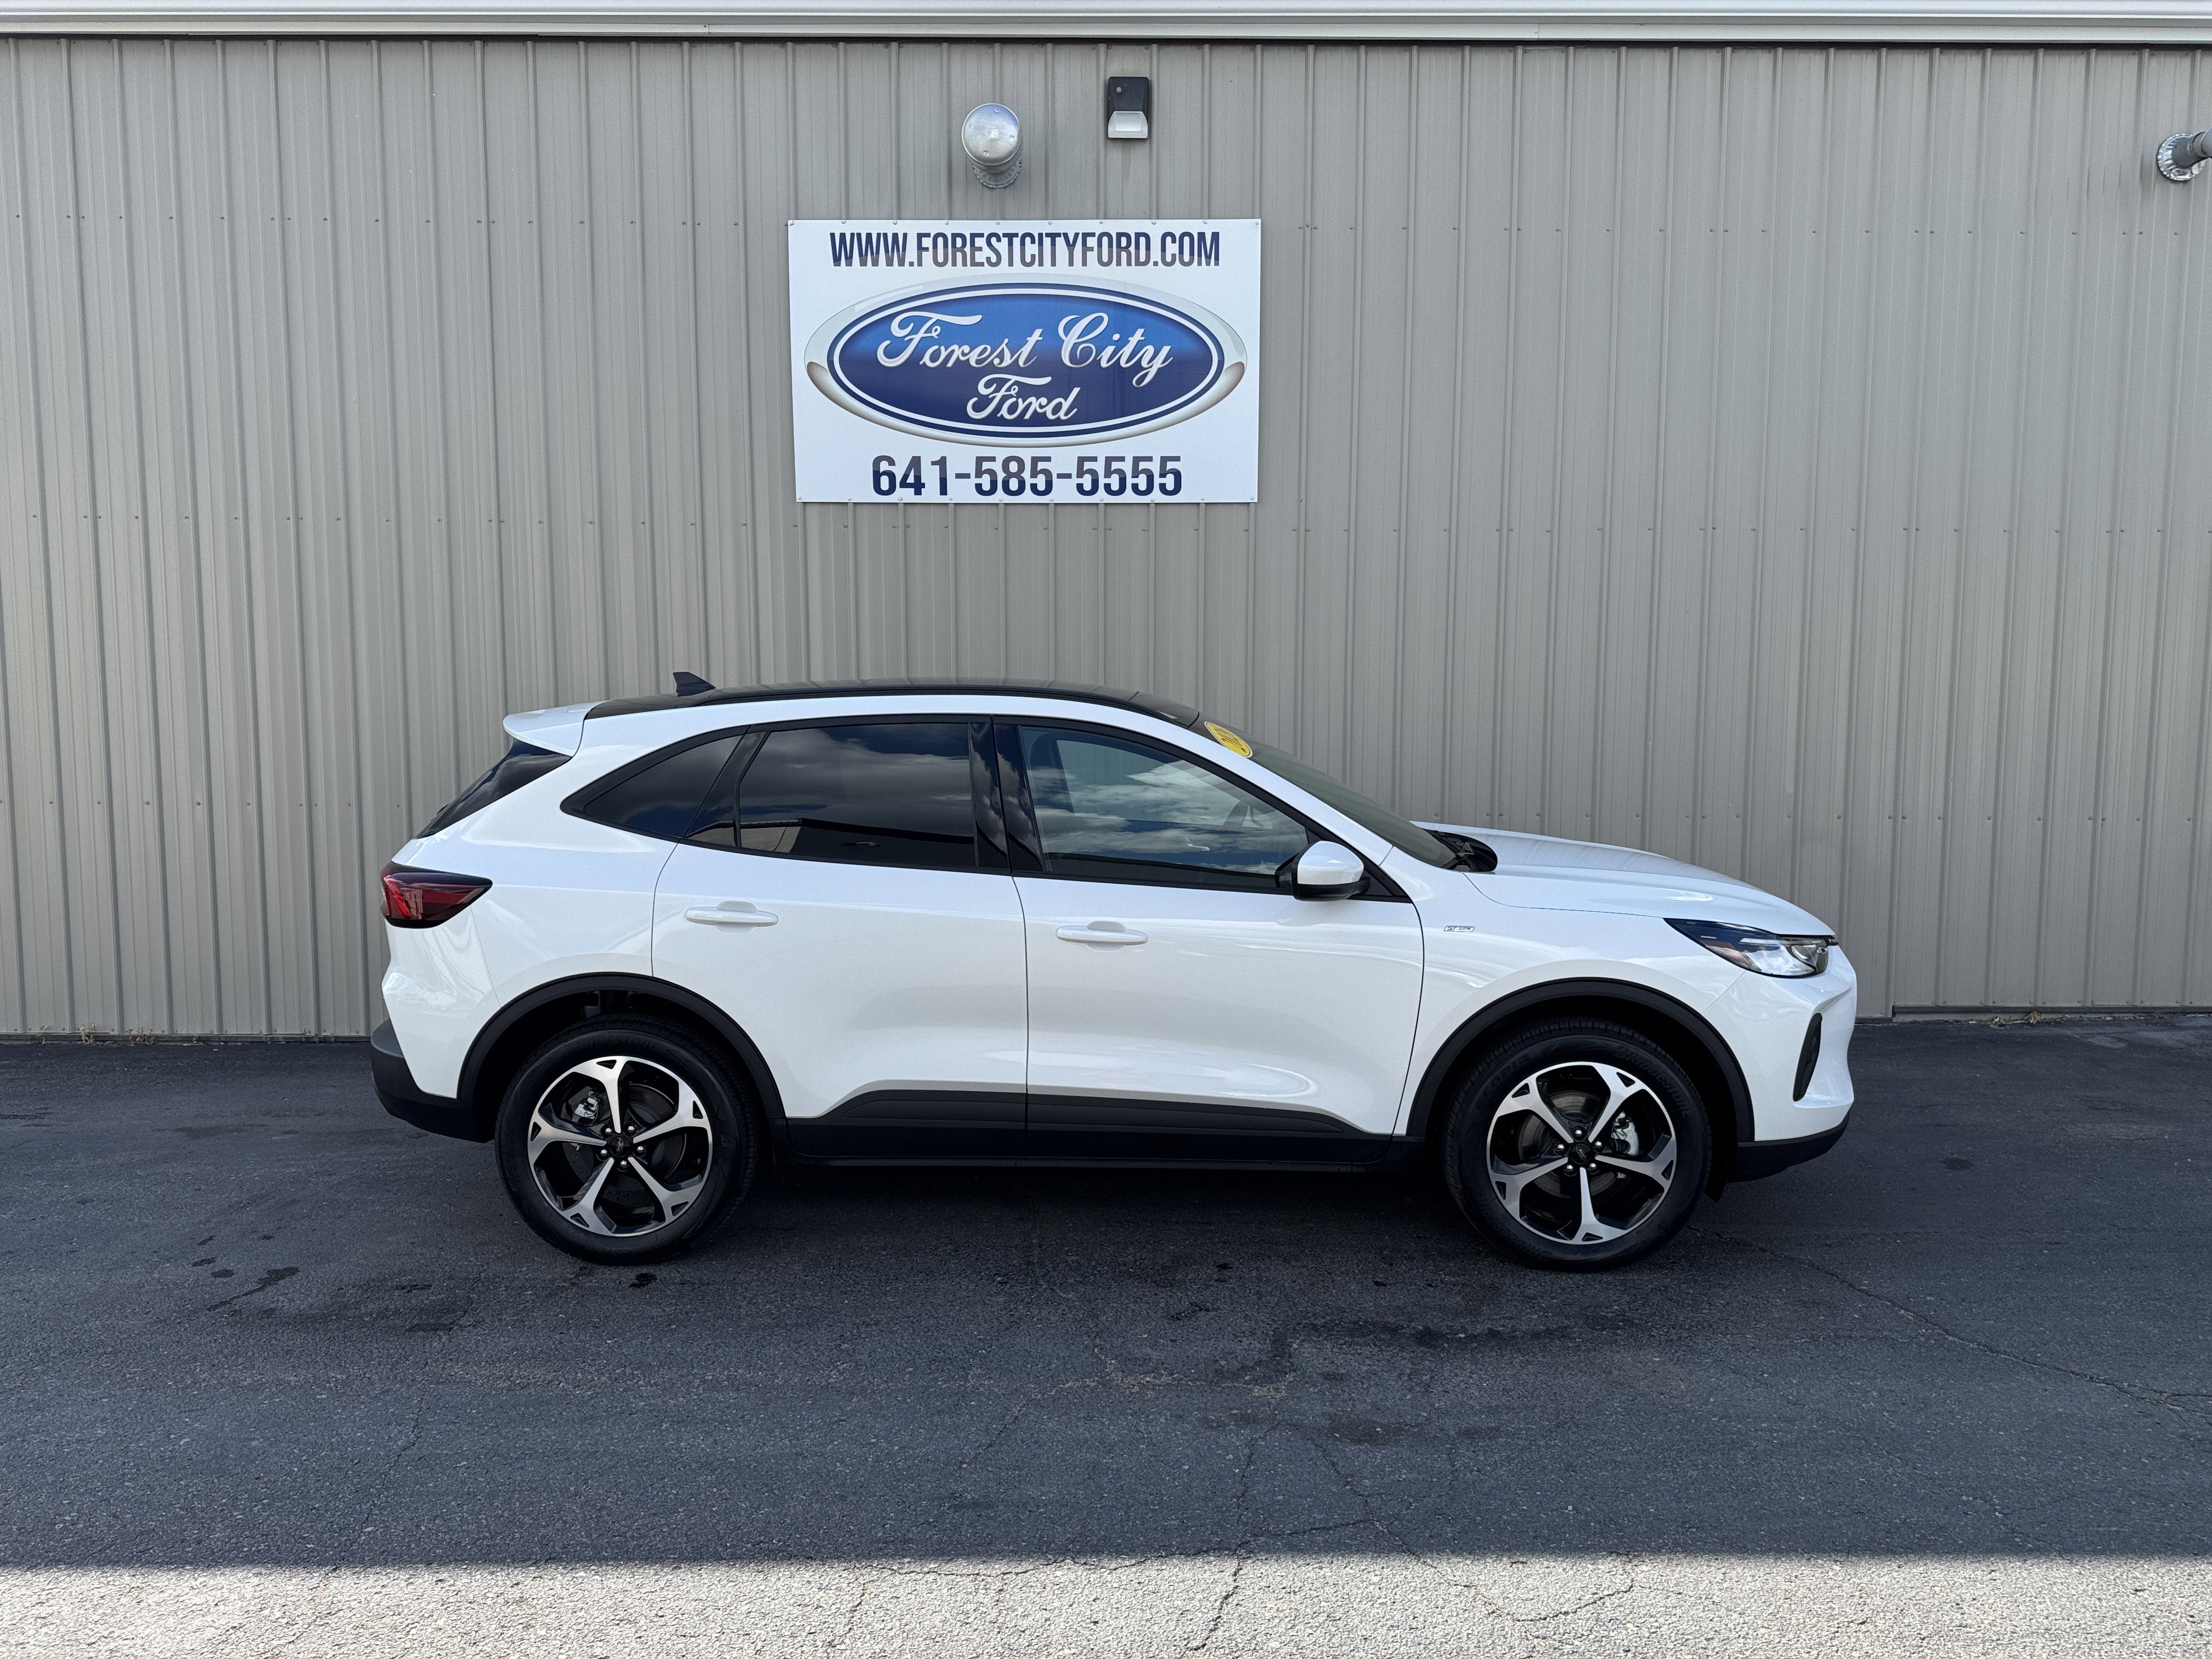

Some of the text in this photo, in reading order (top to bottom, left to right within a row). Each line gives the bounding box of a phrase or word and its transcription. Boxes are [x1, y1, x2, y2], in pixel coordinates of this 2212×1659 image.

[830, 232, 1219, 268] WWW.FORESTCITYFORD.COM
[877, 311, 1173, 387] Forest City
[966, 374, 1081, 420] Ford
[872, 455, 1182, 496] 641-585-5555
